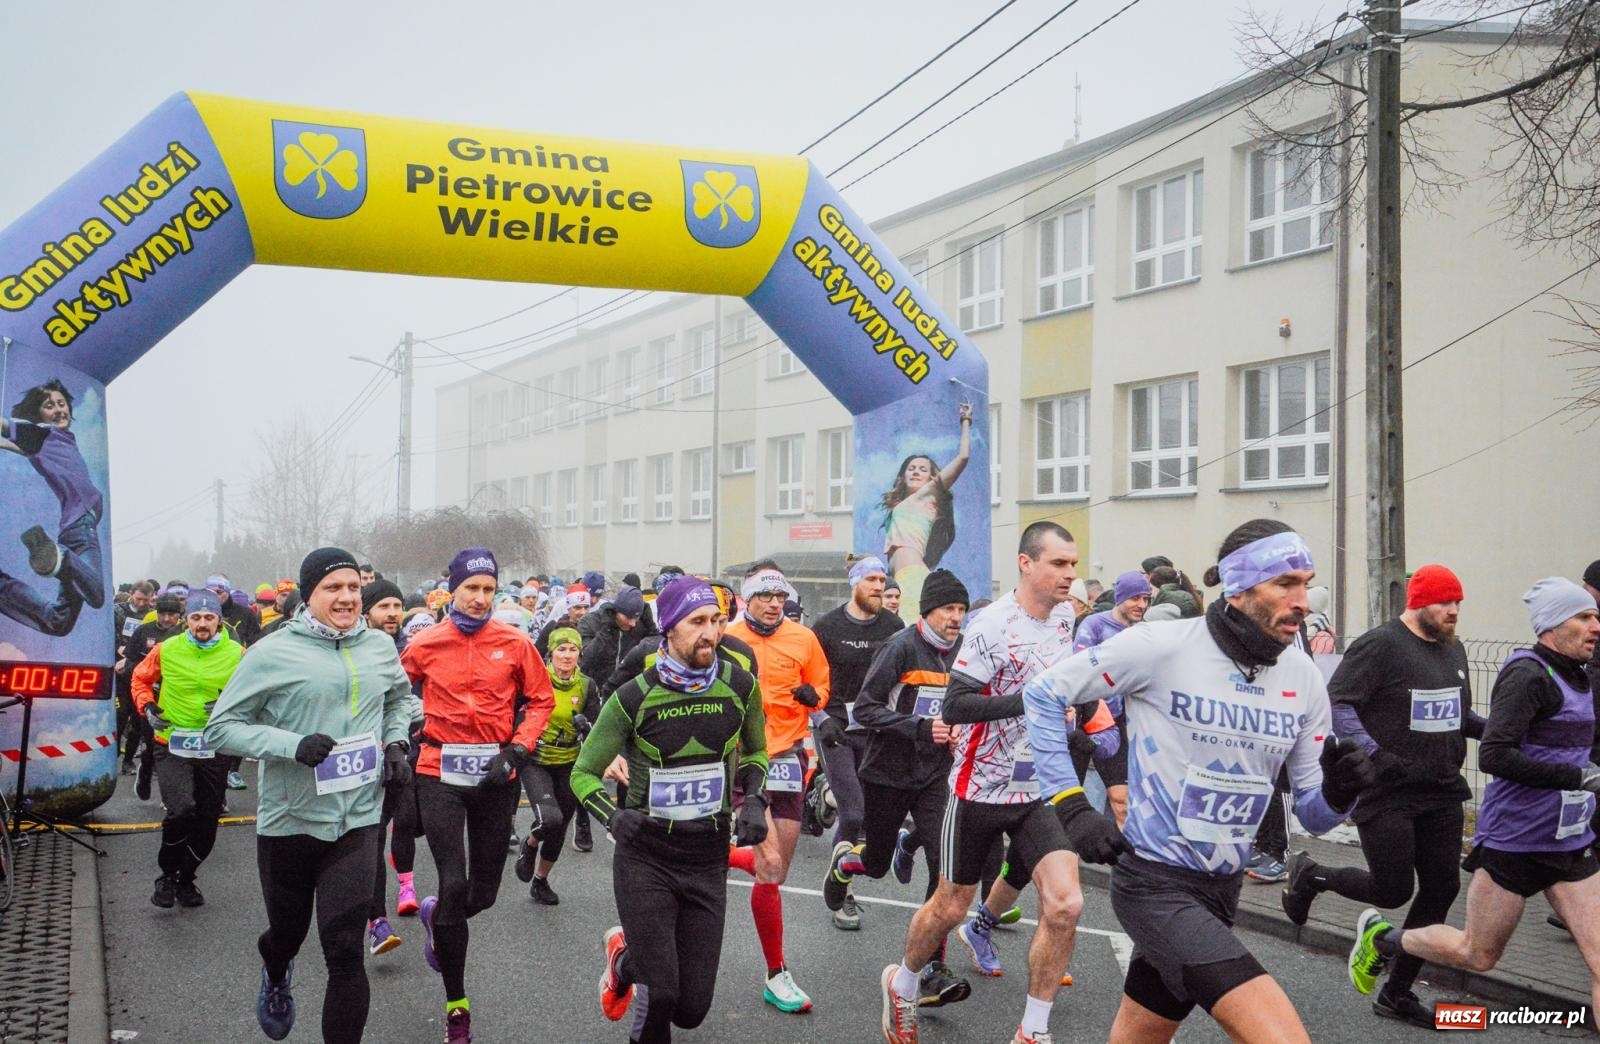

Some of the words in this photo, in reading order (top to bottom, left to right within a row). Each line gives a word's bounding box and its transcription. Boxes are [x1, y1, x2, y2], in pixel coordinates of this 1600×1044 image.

[447, 137, 609, 173] Gmina
[405, 163, 652, 213] Pietrowice
[0, 217, 113, 311] Gmina
[100, 141, 200, 225] ludzi
[438, 205, 619, 247] Wielkie
[43, 186, 232, 348] aktywnych
[818, 203, 893, 296] Gmina
[892, 286, 959, 361] ludzi
[793, 236, 931, 384] aktywnych
[657, 703, 723, 720] WOLVERIN
[1424, 701, 1455, 719] 172
[183, 737, 202, 750] 64
[336, 750, 365, 776] 86
[768, 764, 790, 780] 48
[664, 780, 712, 806] 115
[1197, 792, 1256, 823] 164
